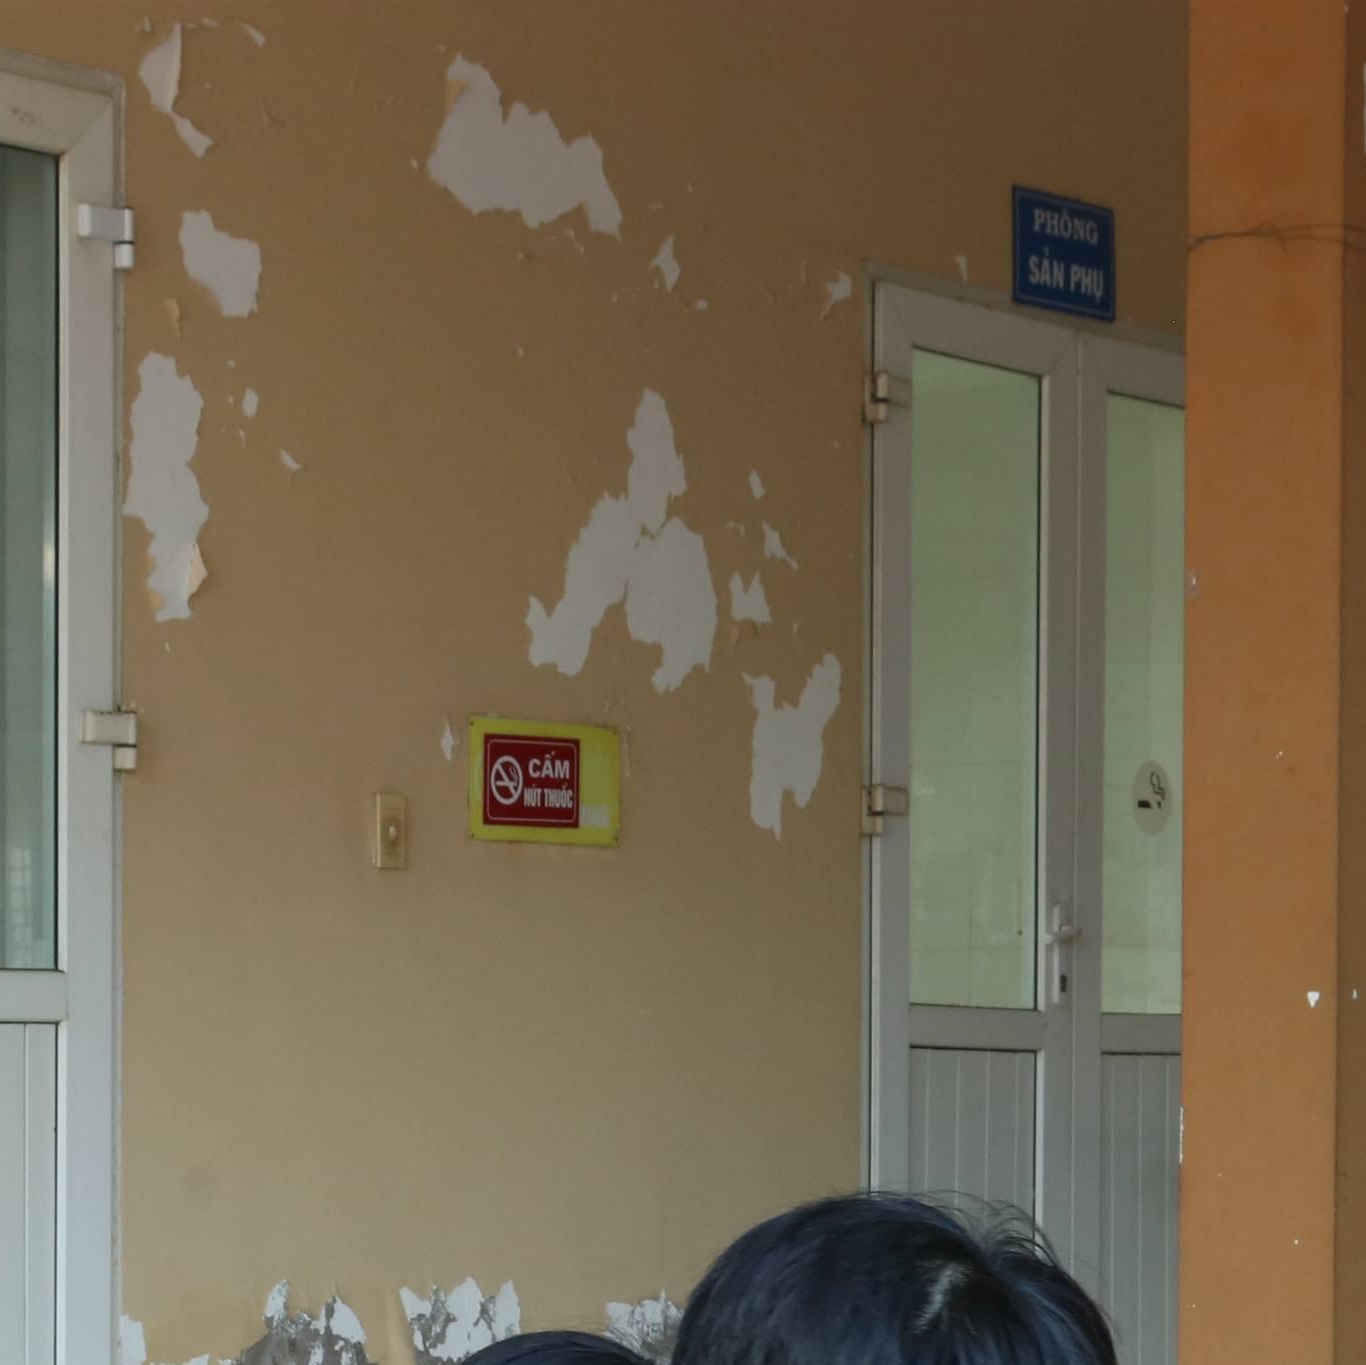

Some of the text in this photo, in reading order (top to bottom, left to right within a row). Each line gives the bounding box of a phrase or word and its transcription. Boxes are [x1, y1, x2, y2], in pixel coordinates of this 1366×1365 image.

[1032, 207, 1099, 245] PHÒNG
[1028, 246, 1103, 303] SẢN PHỤ
[528, 750, 570, 779] CẤM
[524, 782, 573, 809] HÚT THUỐC
